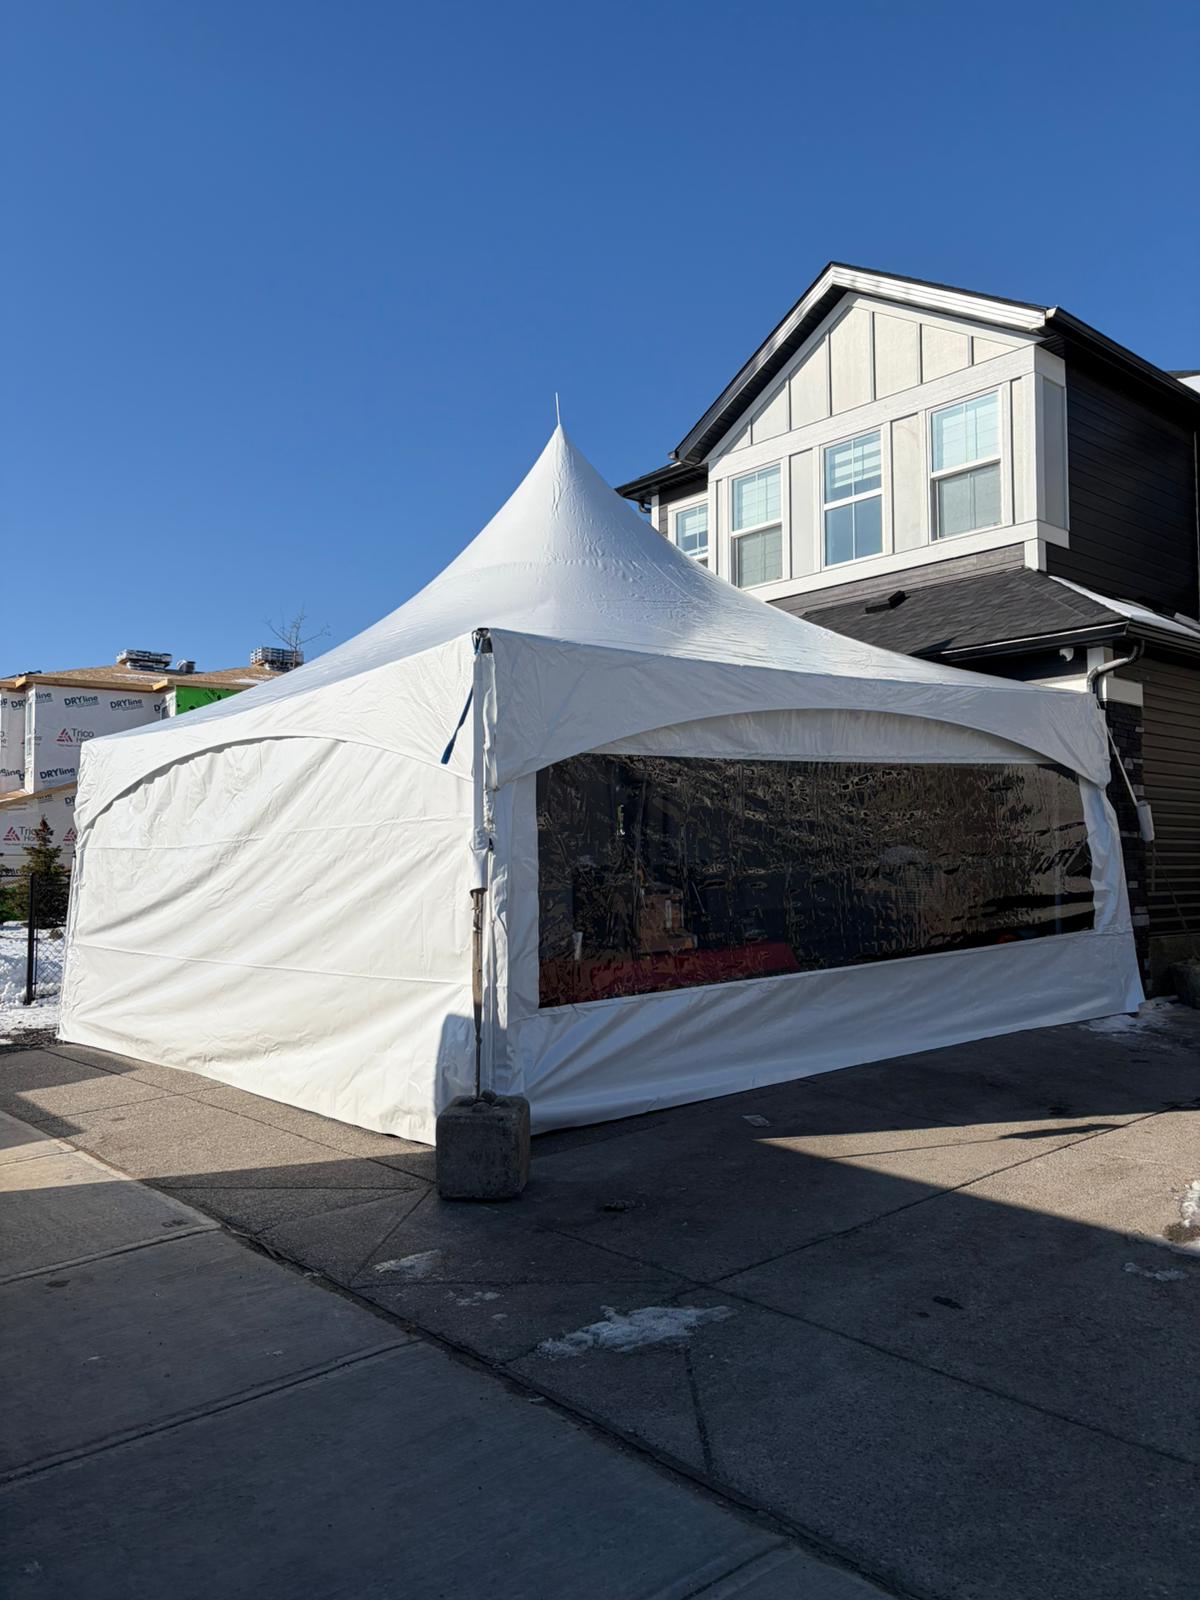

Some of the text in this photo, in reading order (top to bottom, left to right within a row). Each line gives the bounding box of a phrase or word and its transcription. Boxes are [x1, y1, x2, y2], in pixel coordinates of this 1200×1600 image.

[64, 695, 98, 706] DRYline
[110, 698, 142, 709] DRYline
[71, 728, 94, 738] Trico
[40, 768, 75, 779] DRYline
